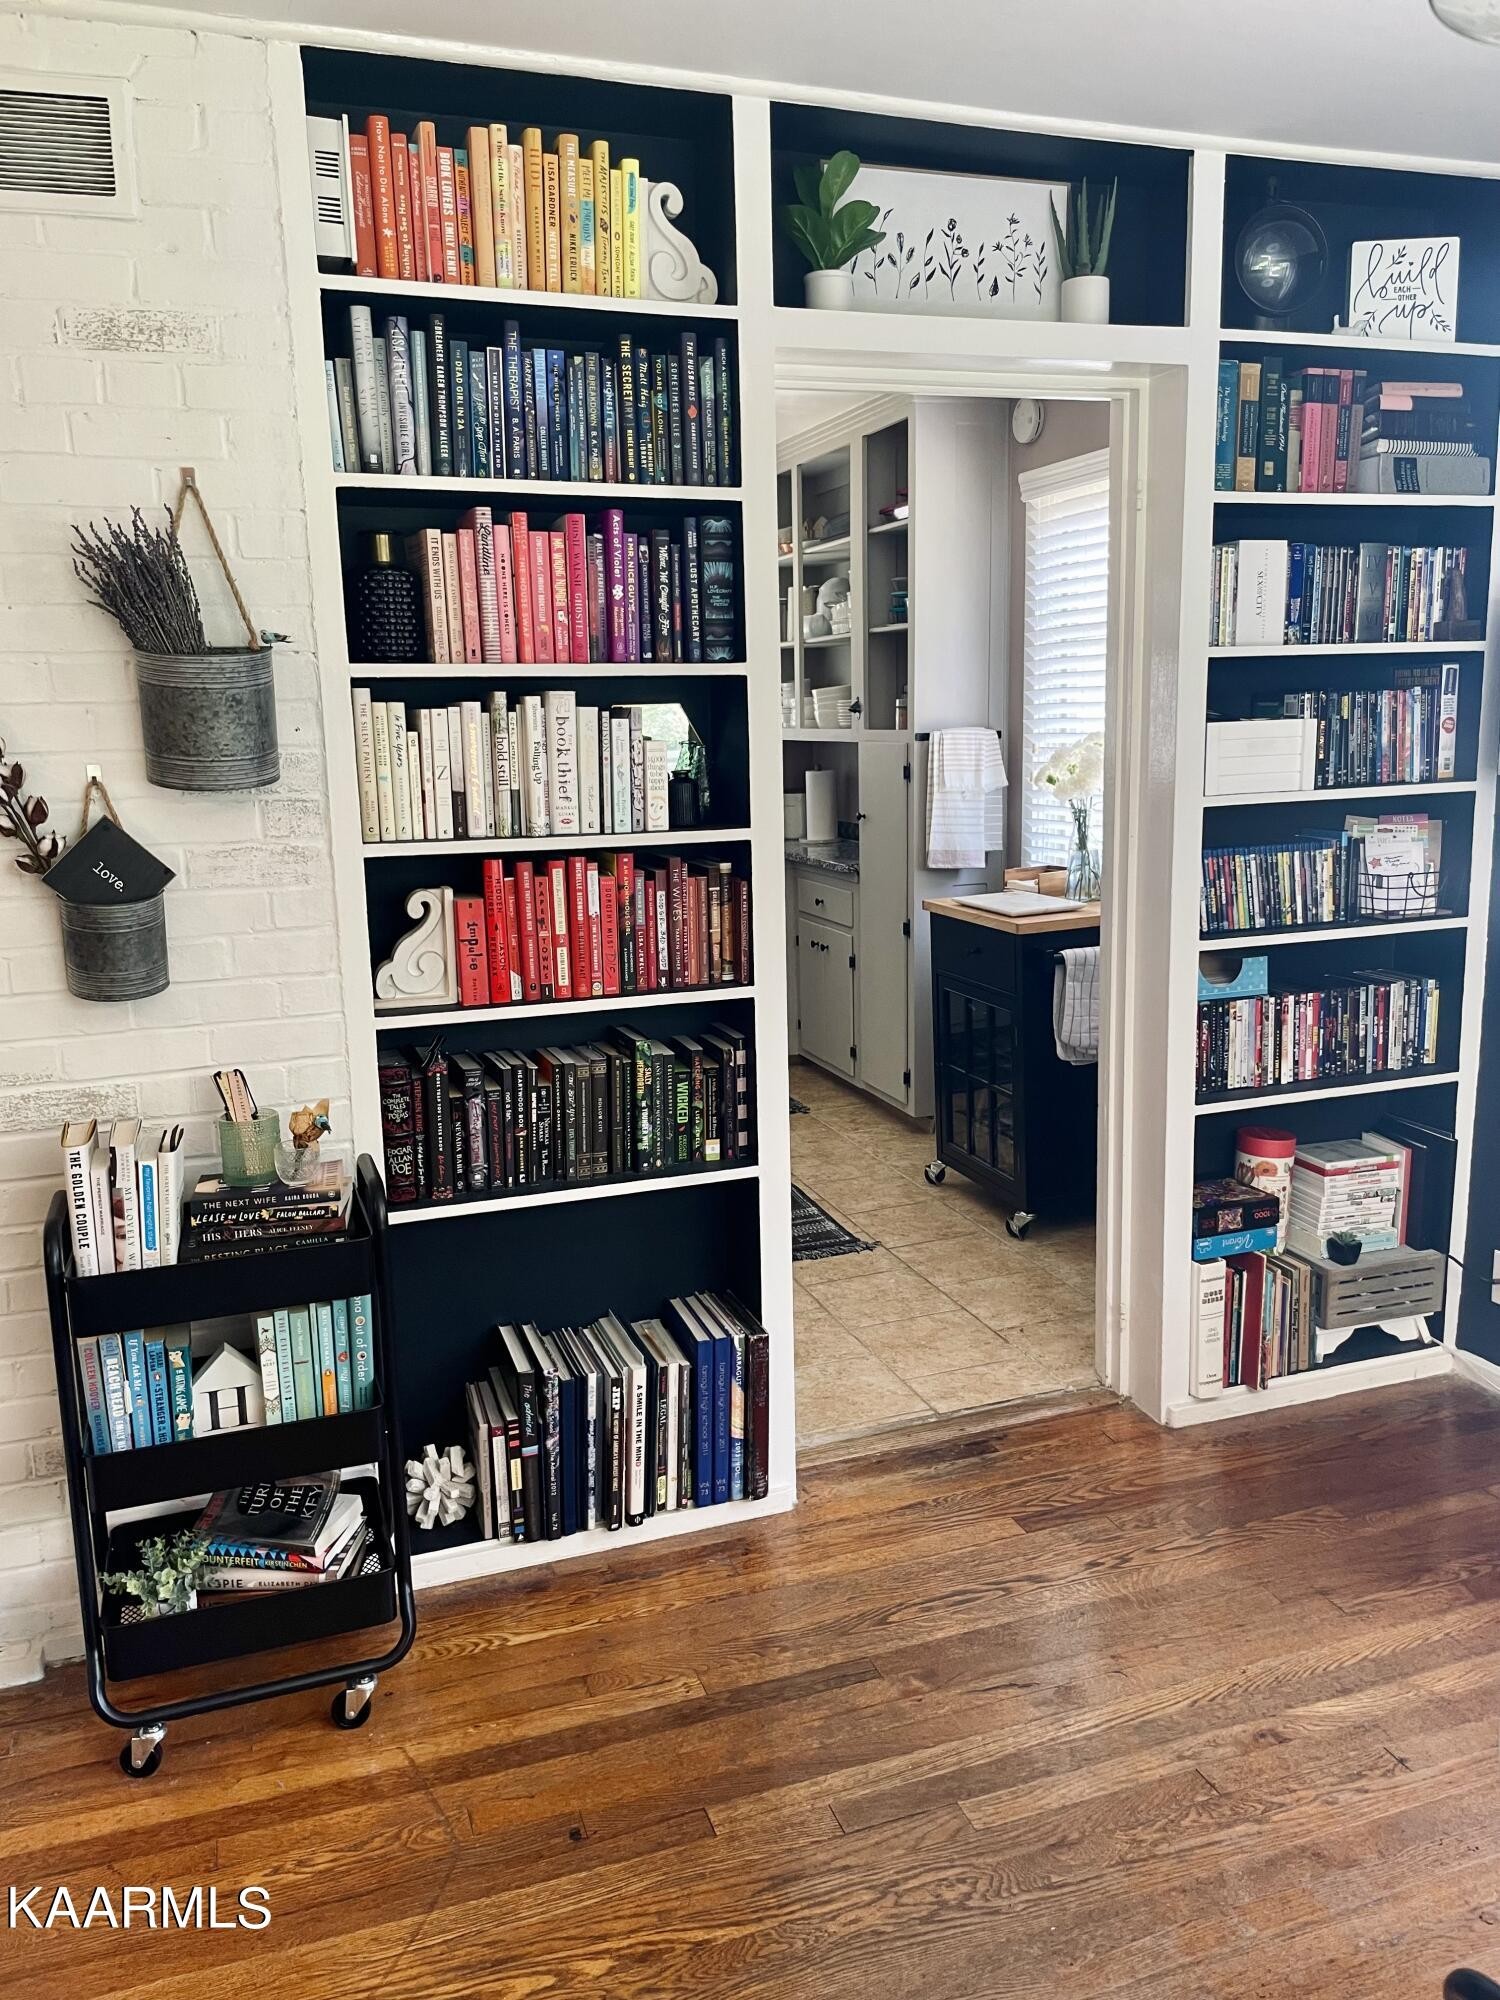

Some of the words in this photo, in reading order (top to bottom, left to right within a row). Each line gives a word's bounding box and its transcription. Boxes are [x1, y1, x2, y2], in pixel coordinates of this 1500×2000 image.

[567, 143, 575, 156] THE
[440, 152, 450, 178] BOOK
[547, 161, 555, 182] LISA
[567, 160, 576, 198] MEASURE
[441, 180, 453, 215] LOVERS
[548, 185, 556, 227] GARDNER
[444, 222, 455, 247] EMILY
[446, 250, 456, 277] HENRY
[569, 256, 577, 282] ERLICK
[1354, 243, 1449, 312] build
[1379, 300, 1434, 340] up
[391, 329, 402, 352] LISA
[434, 326, 444, 362] DREAMERS
[507, 331, 517, 351] THE
[620, 340, 631, 358] THE
[686, 342, 694, 356] THE
[393, 356, 406, 396] JEWELL
[455, 361, 464, 384] DEAD
[524, 358, 532, 387] HARPER
[588, 356, 596, 371] THE
[436, 366, 445, 388] KAREN
[508, 355, 519, 412] THERAPIST
[671, 363, 679, 413] SOMETIMES
[687, 359, 695, 401] HUSBANDS
[456, 386, 464, 405] GIRL
[588, 375, 597, 426] BREAKDOWN
[622, 364, 633, 419] SECRETARY
[398, 402, 410, 437] INVISIBLE
[437, 390, 447, 428] THOMPSON
[457, 407, 464, 416] IN
[457, 419, 465, 430] 2A
[400, 441, 410, 457] GIRL
[439, 430, 448, 458] WALKER
[612, 514, 621, 535] Acts
[431, 547, 439, 566] ENDS
[477, 523, 491, 576] Landline
[614, 538, 622, 549] of
[614, 550, 623, 578] Violet
[689, 562, 697, 584] LOST
[433, 568, 441, 588] WITH
[434, 590, 442, 600] US
[574, 593, 583, 637] GHOSTED
[691, 588, 699, 643] APOTHECARY
[361, 722, 370, 748] SILENT
[555, 716, 570, 758] book
[496, 736, 508, 762] hold
[532, 741, 541, 771] Falling
[363, 752, 371, 784] PATIENT
[498, 765, 509, 787] still
[533, 772, 543, 784] Up
[557, 762, 572, 802] thief
[92, 861, 124, 892] love.
[487, 875, 495, 918] PICTURES
[672, 887, 681, 921] WIVES
[459, 921, 483, 971] impulse
[636, 1060, 644, 1094] HEPWORTH
[676, 1081, 689, 1124] WICKED
[415, 1114, 423, 1132] KING
[69, 1151, 81, 1169] THE
[387, 1146, 413, 1157] EDGAR
[392, 1163, 412, 1174] POE
[72, 1173, 85, 1209] GOLDEN
[124, 1187, 133, 1201] MY
[203, 1202, 222, 1210] THE
[225, 1199, 249, 1208] NEXT
[254, 1196, 277, 1205] WIFE
[75, 1214, 90, 1249] COUPLE
[126, 1208, 134, 1247] LOVELY
[355, 1315, 365, 1335] Out
[129, 1338, 138, 1347] If
[130, 1348, 139, 1362] You
[356, 1337, 367, 1348] of
[83, 1347, 98, 1380] COLLEEN
[105, 1356, 121, 1389] BEACH
[131, 1363, 141, 1378] Ask
[356, 1351, 367, 1382] Order
[133, 1379, 142, 1391] Me
[698, 1365, 709, 1397] farragut
[716, 1362, 727, 1392] farragut
[88, 1381, 100, 1411] HOOVER
[109, 1391, 124, 1417] READ
[154, 1387, 167, 1425] STRANGER
[176, 1395, 187, 1412] GAME
[612, 1386, 620, 1410] JEEP
[635, 1393, 643, 1417] SMILE
[699, 1397, 709, 1412] high
[717, 1394, 726, 1410] high
[636, 1419, 643, 1428] IN
[658, 1399, 667, 1426] LEGAL
[718, 1412, 726, 1436] school
[270, 1491, 284, 1508] OF
[284, 1486, 305, 1514] THE
[301, 1486, 323, 1519] KEY
